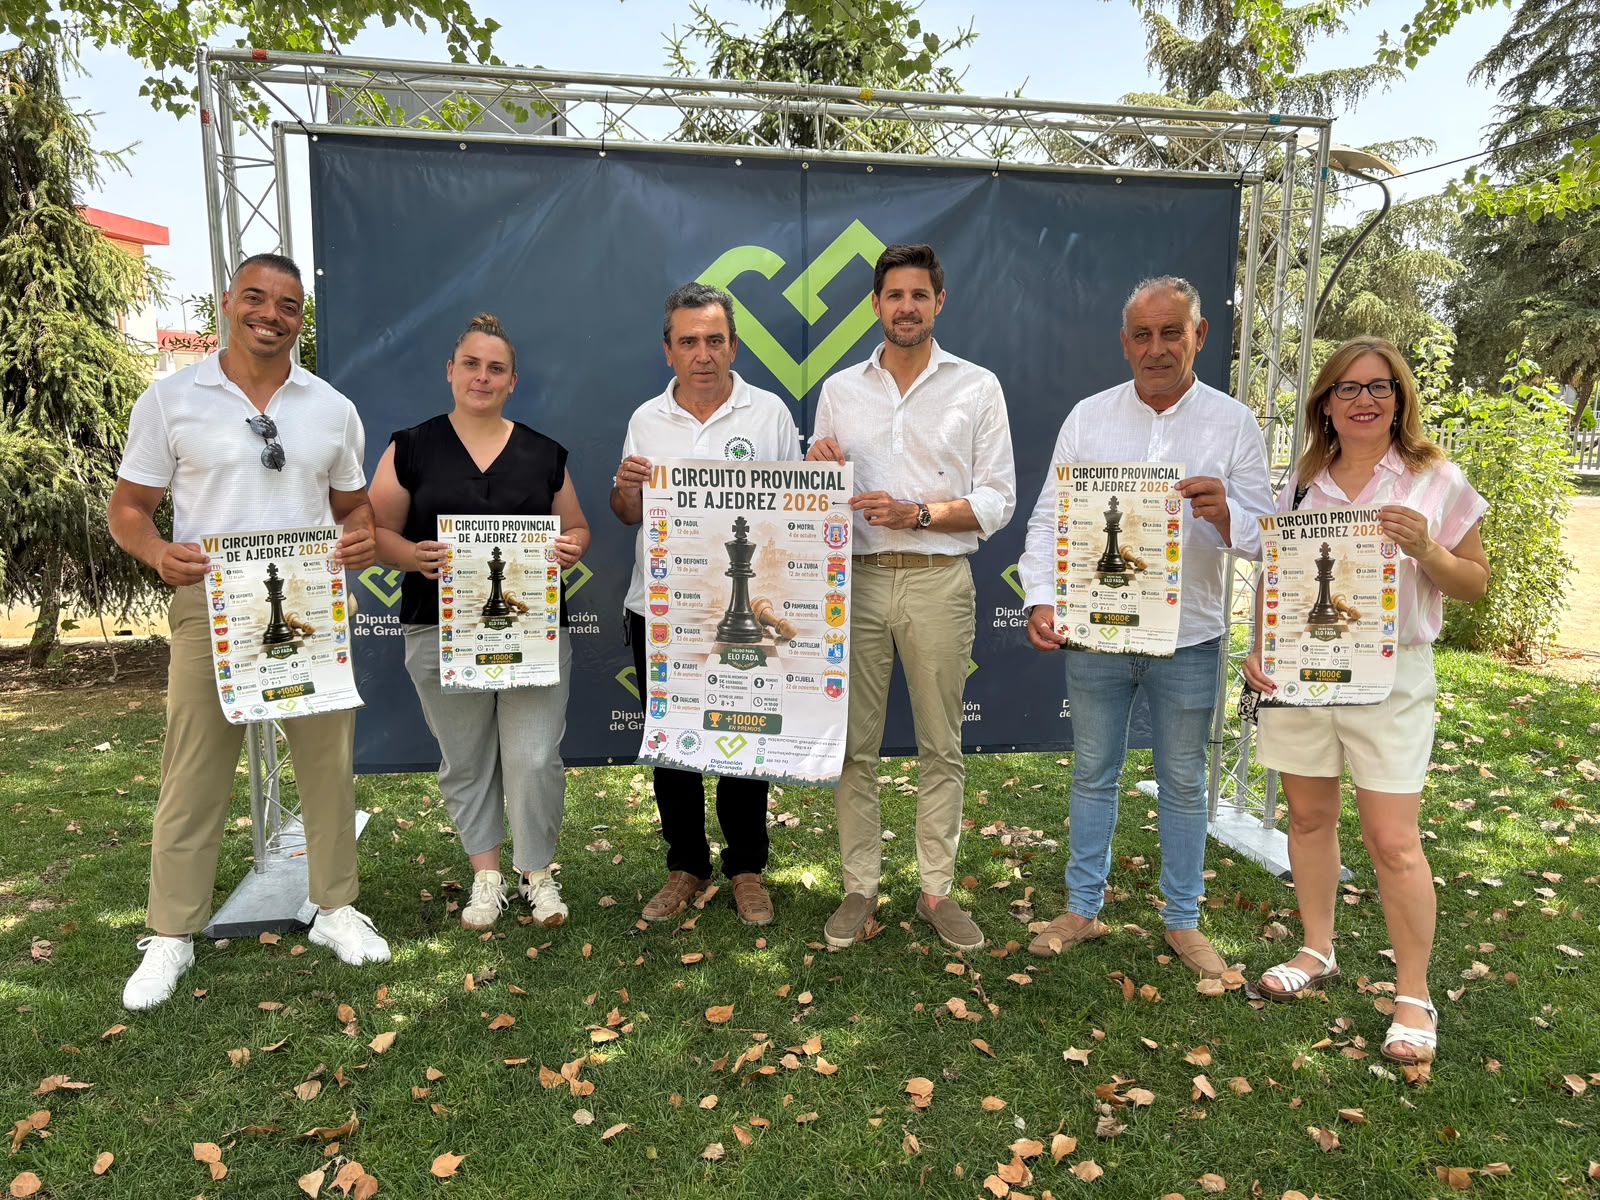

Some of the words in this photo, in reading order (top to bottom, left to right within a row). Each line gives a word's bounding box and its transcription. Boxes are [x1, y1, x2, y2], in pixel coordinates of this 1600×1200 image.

[672, 468, 746, 488] CIRCUITO
[751, 470, 845, 490] PROVINCIAL
[1056, 467, 1069, 480] VI
[1072, 468, 1118, 479] CIRCUITO
[1122, 468, 1180, 480] PROVINCIAL
[1076, 482, 1088, 491] DE
[1092, 481, 1136, 492] AJEDREZ
[1140, 481, 1169, 492] 2026
[678, 491, 697, 508] DE
[704, 491, 776, 510] AJEDREZ
[783, 493, 829, 512] 2026
[439, 519, 452, 532] VI
[456, 520, 500, 531] CIRCUITO
[502, 520, 556, 531] PROVINCIAL
[1259, 517, 1275, 530] VI
[1277, 513, 1327, 527] CIRCUITO
[1282, 529, 1296, 539] DE
[1301, 526, 1348, 539] AJEDREZ
[1352, 524, 1384, 536] 2026
[203, 538, 218, 552] VI
[222, 534, 274, 549] CIRCUITO
[278, 530, 338, 544] PROVINCIAL
[459, 533, 470, 542] DE
[475, 533, 517, 543] AJEDREZ
[521, 533, 547, 543] 2026
[227, 551, 241, 562] DE
[246, 546, 294, 561] AJEDREZ
[299, 543, 328, 556] 2026
[356, 614, 400, 626] Diputa
[993, 619, 1006, 627] de
[1104, 614, 1130, 622] +1000€
[354, 626, 370, 636] de
[569, 624, 600, 634] nada
[277, 685, 304, 695] +1000€
[609, 722, 625, 730] de
[726, 714, 767, 726] +1000€
